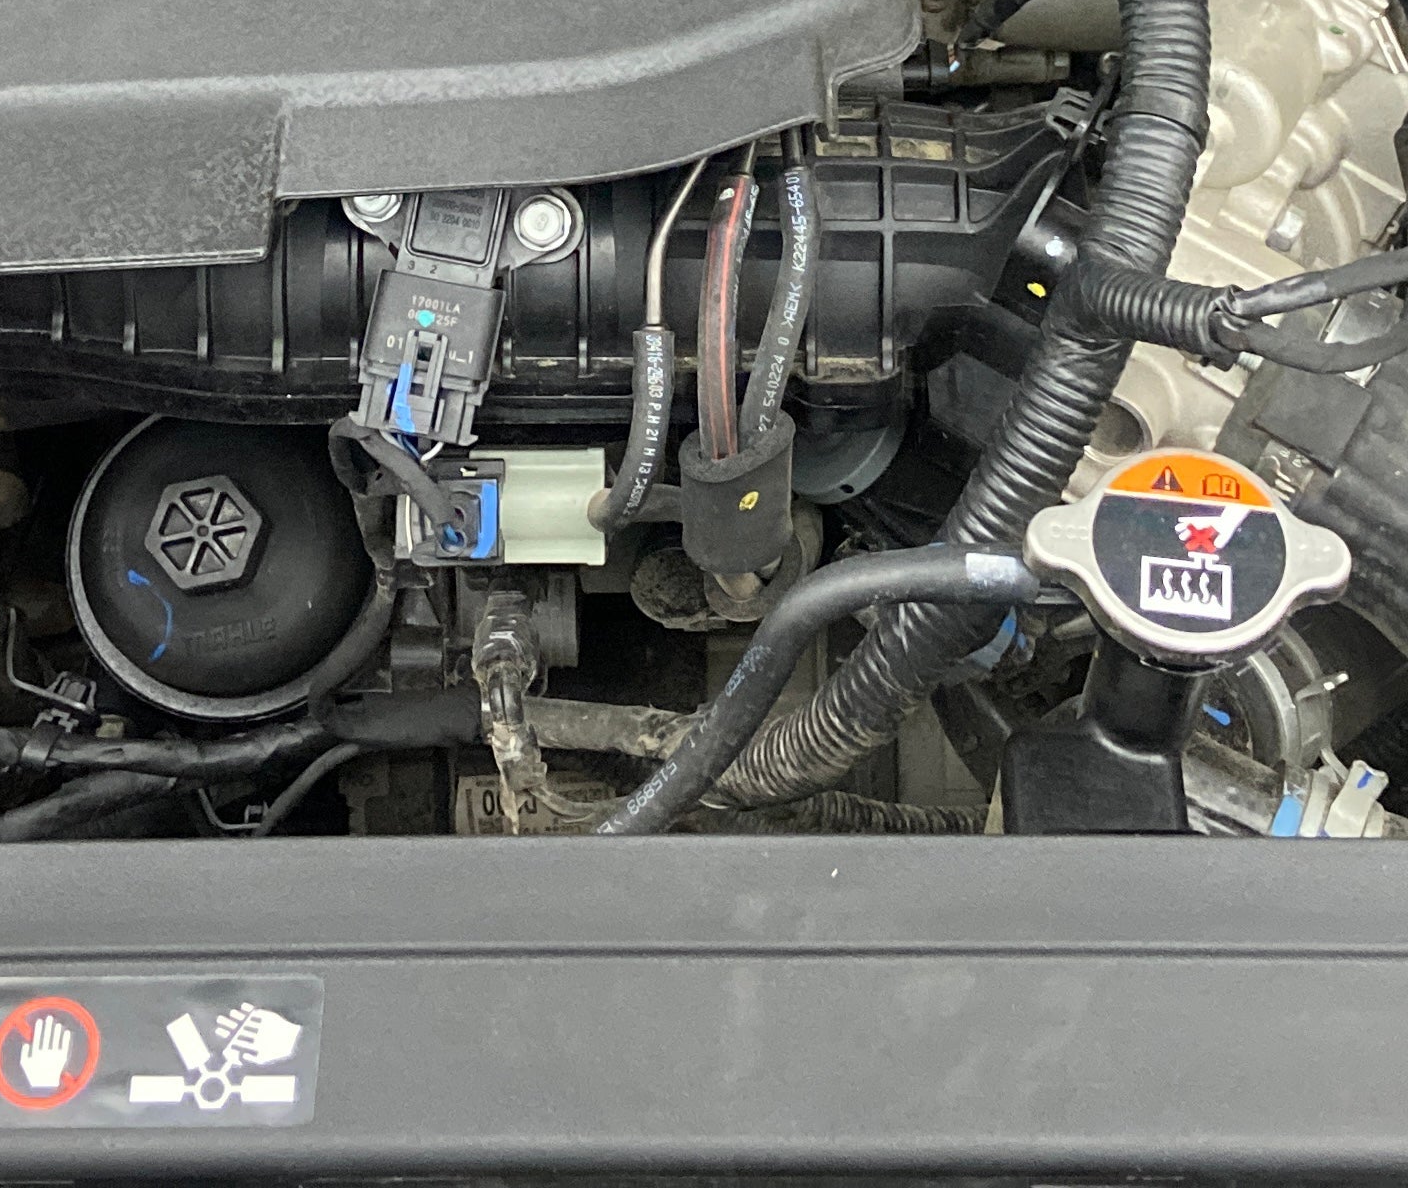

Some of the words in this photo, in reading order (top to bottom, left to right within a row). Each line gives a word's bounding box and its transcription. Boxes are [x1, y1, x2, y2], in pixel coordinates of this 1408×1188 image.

[430, 265, 438, 274] 2
[411, 295, 461, 314] 17001LA
[766, 355, 785, 408] 540224
[645, 428, 658, 441] 21
[642, 447, 655, 456] H
